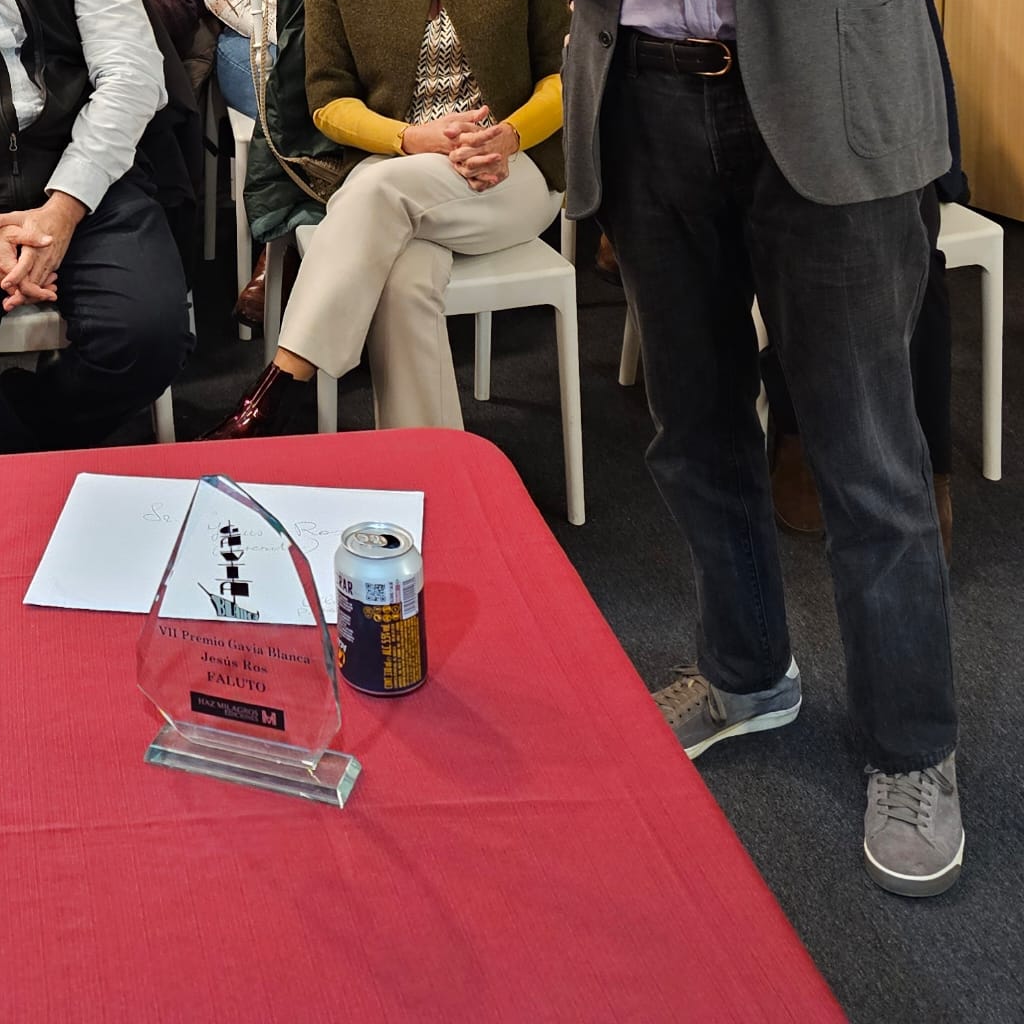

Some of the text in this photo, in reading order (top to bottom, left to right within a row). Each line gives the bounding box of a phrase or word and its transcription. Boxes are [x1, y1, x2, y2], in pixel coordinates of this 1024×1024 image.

[158, 624, 311, 665] VII Premio Gavia Blanca
[200, 651, 268, 674] Jesús Ros
[207, 671, 266, 693] FALUTO
